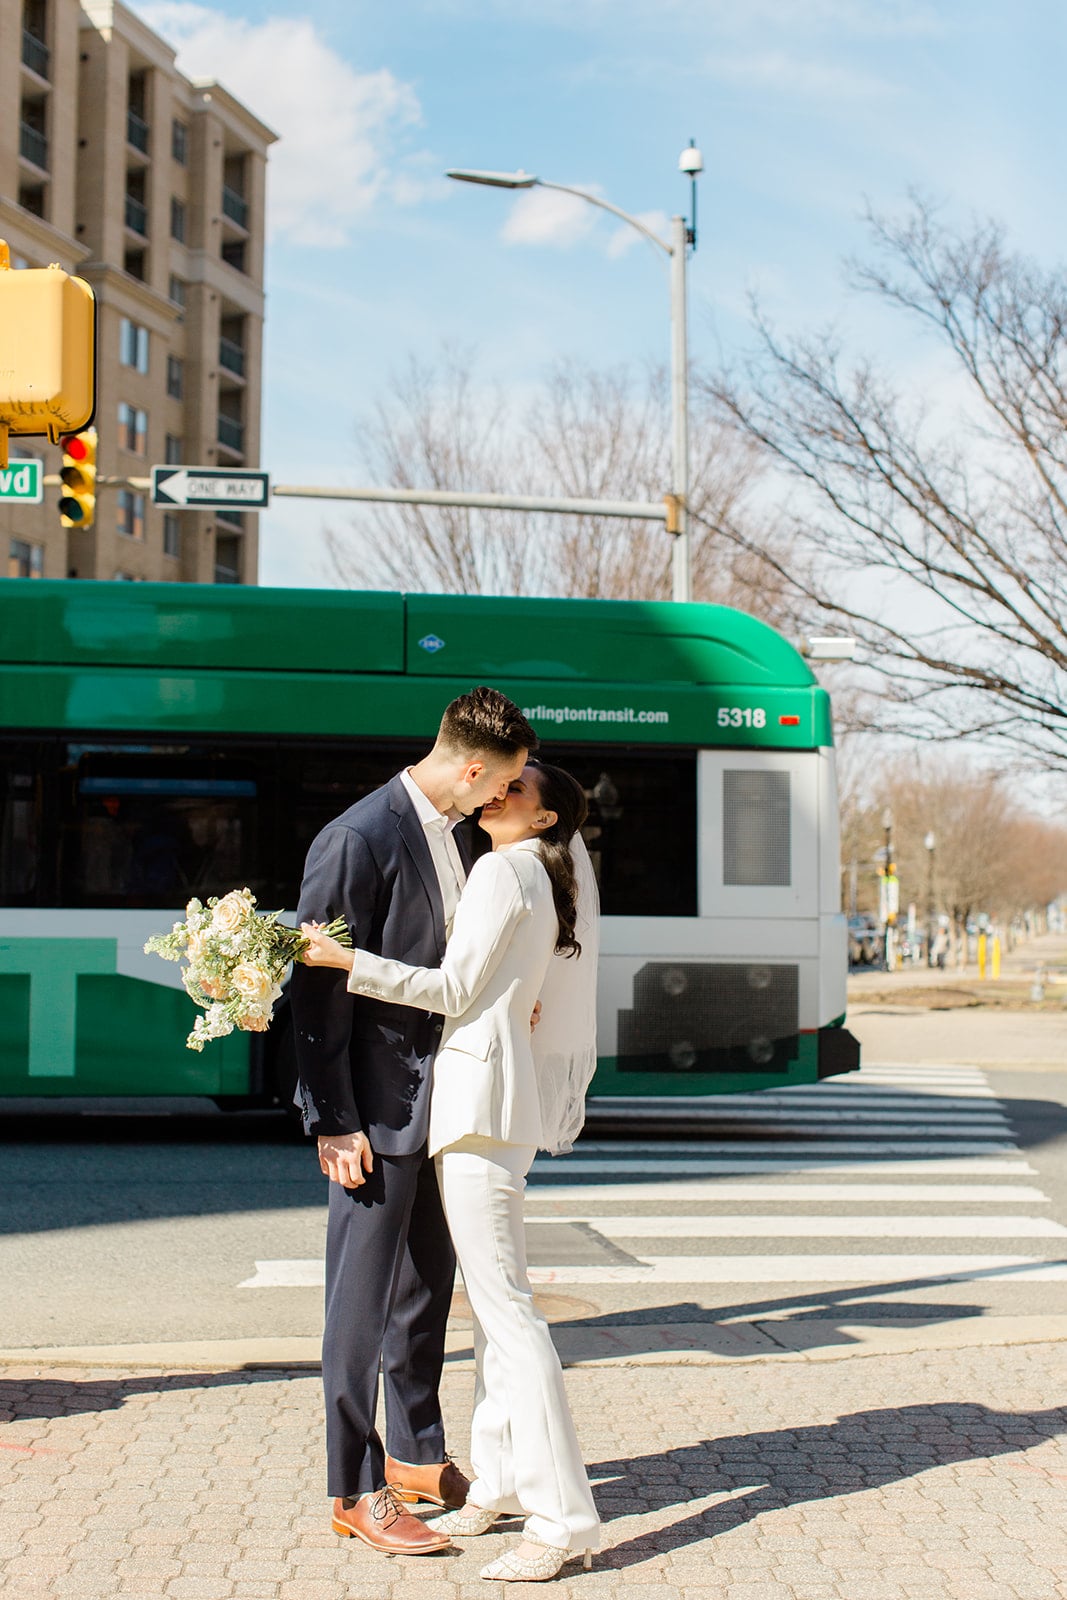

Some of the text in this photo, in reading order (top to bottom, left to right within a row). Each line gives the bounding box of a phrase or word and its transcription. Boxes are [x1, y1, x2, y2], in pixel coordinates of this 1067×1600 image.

[0, 466, 30, 494] vd
[188, 481, 259, 496] ONE WAY
[522, 705, 669, 723] arlingtontransit.com
[717, 707, 767, 728] 5318
